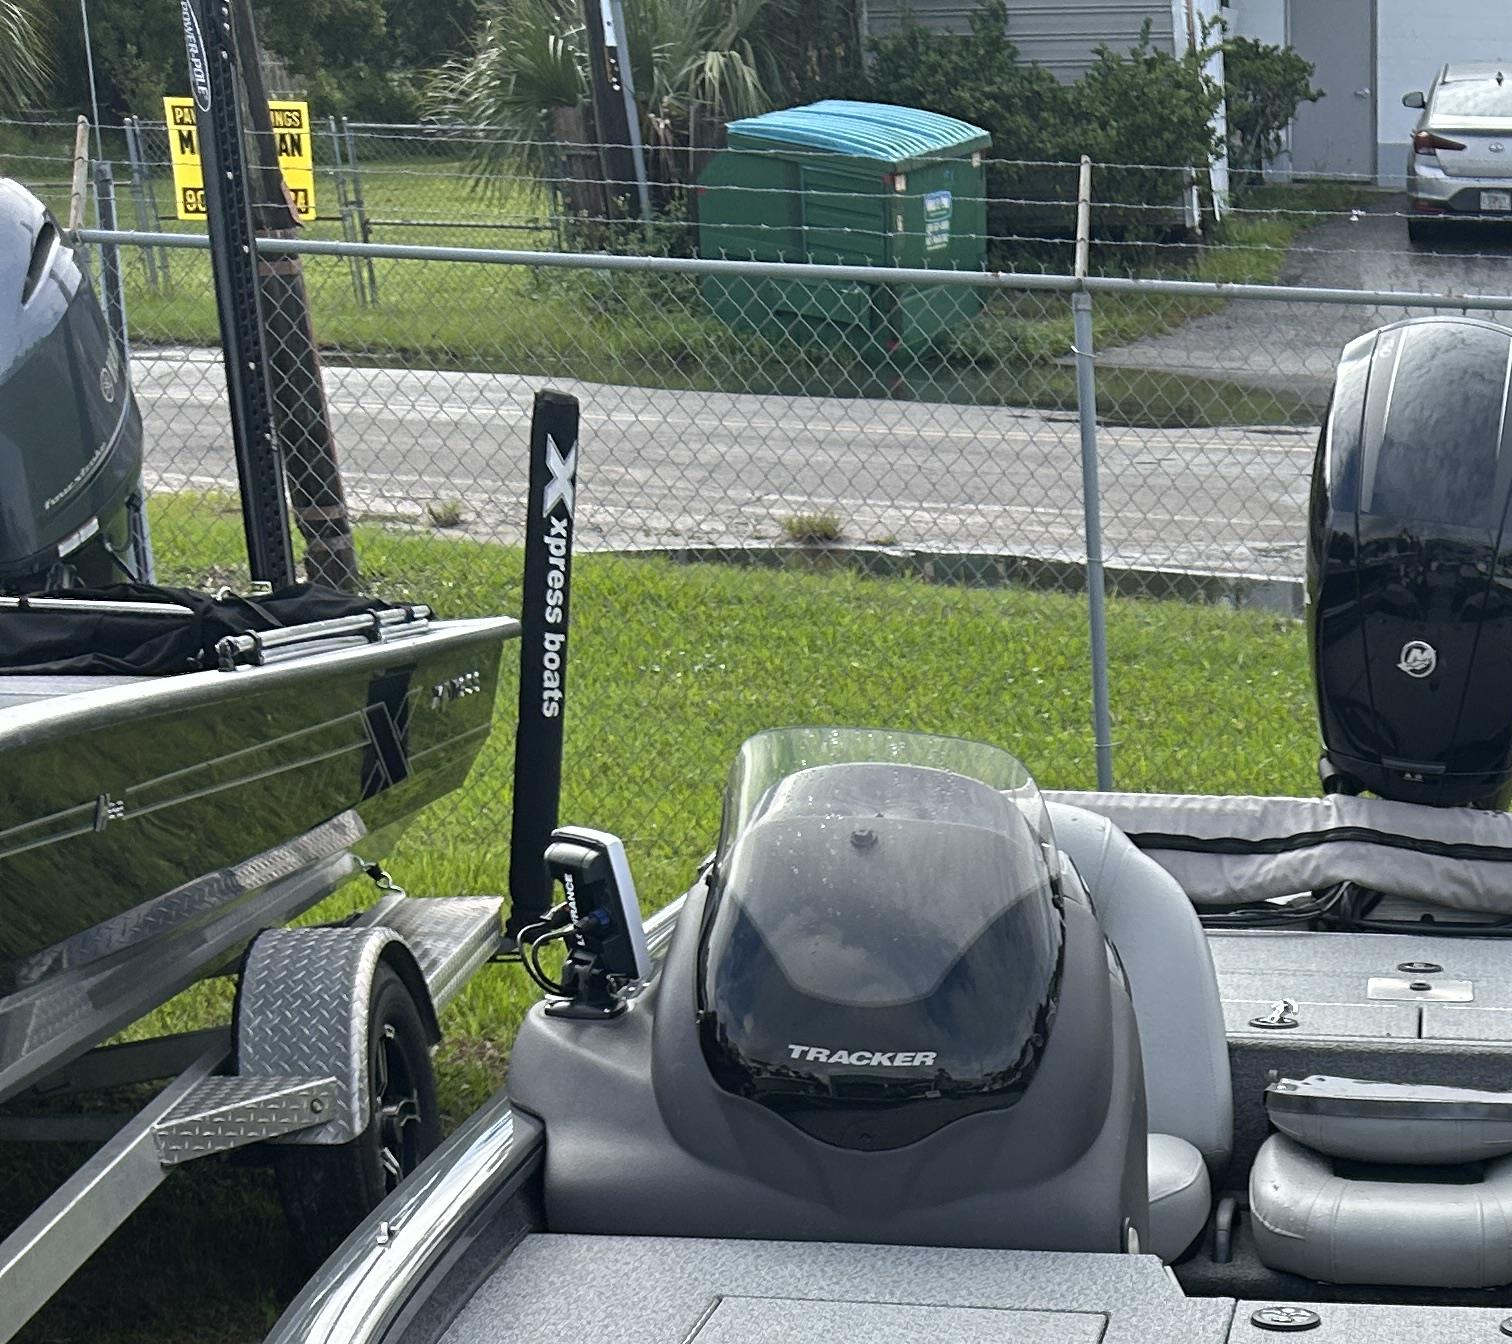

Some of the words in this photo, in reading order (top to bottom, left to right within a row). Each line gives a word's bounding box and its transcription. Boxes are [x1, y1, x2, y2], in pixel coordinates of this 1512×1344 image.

[543, 516, 568, 624] xpress
[541, 631, 567, 718] boats
[787, 1043, 938, 1067] TRACKER
